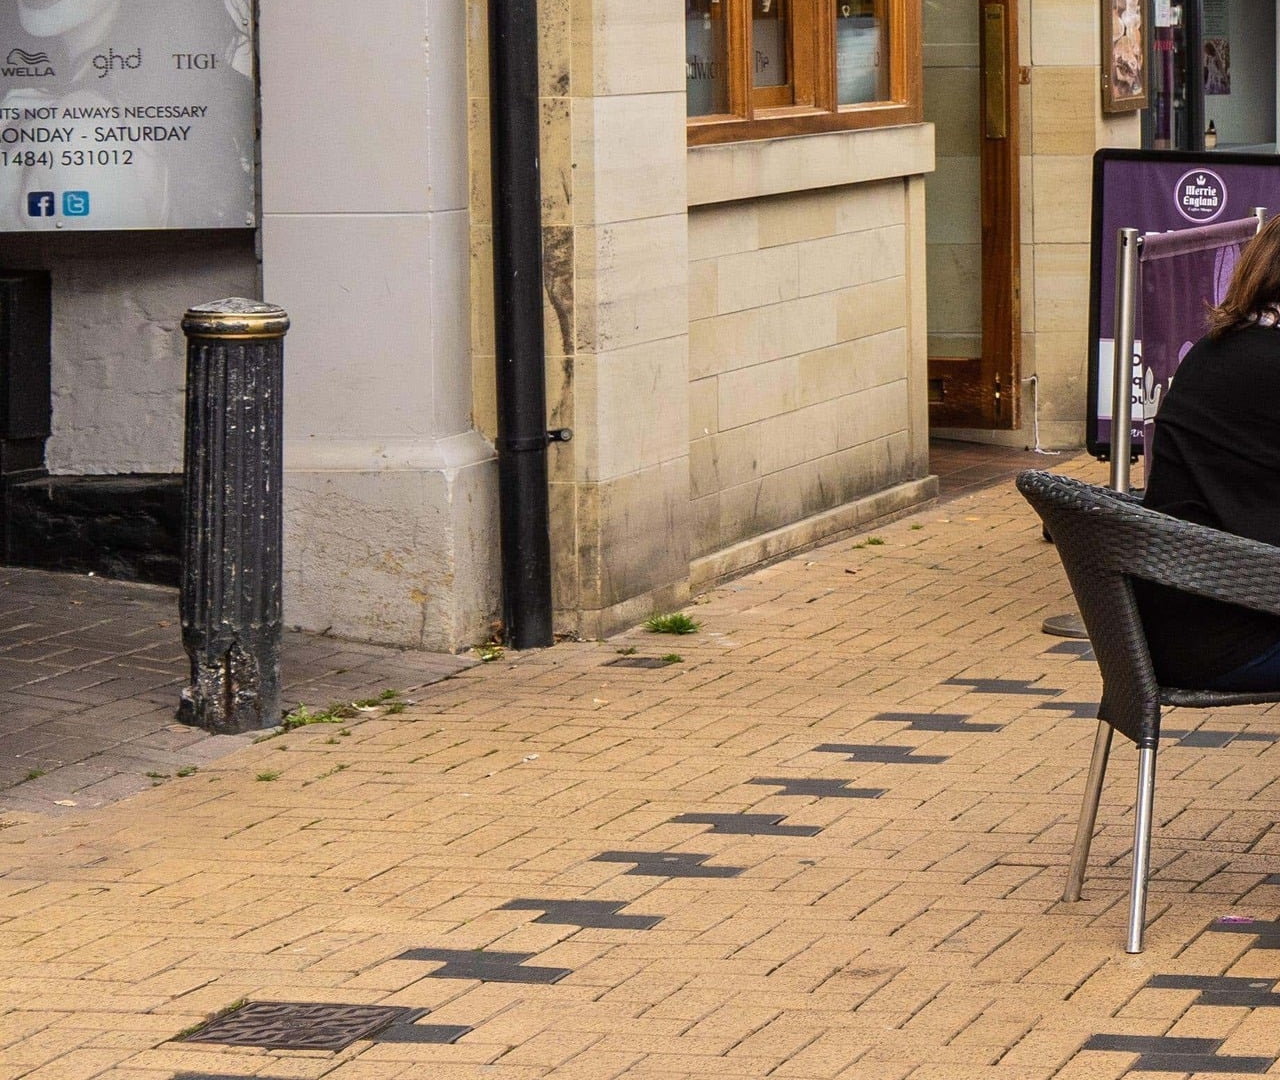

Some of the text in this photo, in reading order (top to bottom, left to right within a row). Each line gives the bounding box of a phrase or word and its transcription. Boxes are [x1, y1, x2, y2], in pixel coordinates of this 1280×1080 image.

[92, 47, 142, 78] ghd
[172, 53, 219, 70] TIGI
[2, 67, 56, 77] WELLA
[24, 107, 59, 120] NOT
[62, 106, 120, 119] ALWAYS
[124, 105, 208, 118] NECESSARY
[94, 126, 191, 141] SATURDAY
[60, 149, 133, 166] 531012
[1185, 185, 1217, 196] Merrie
[1183, 196, 1218, 208] England
